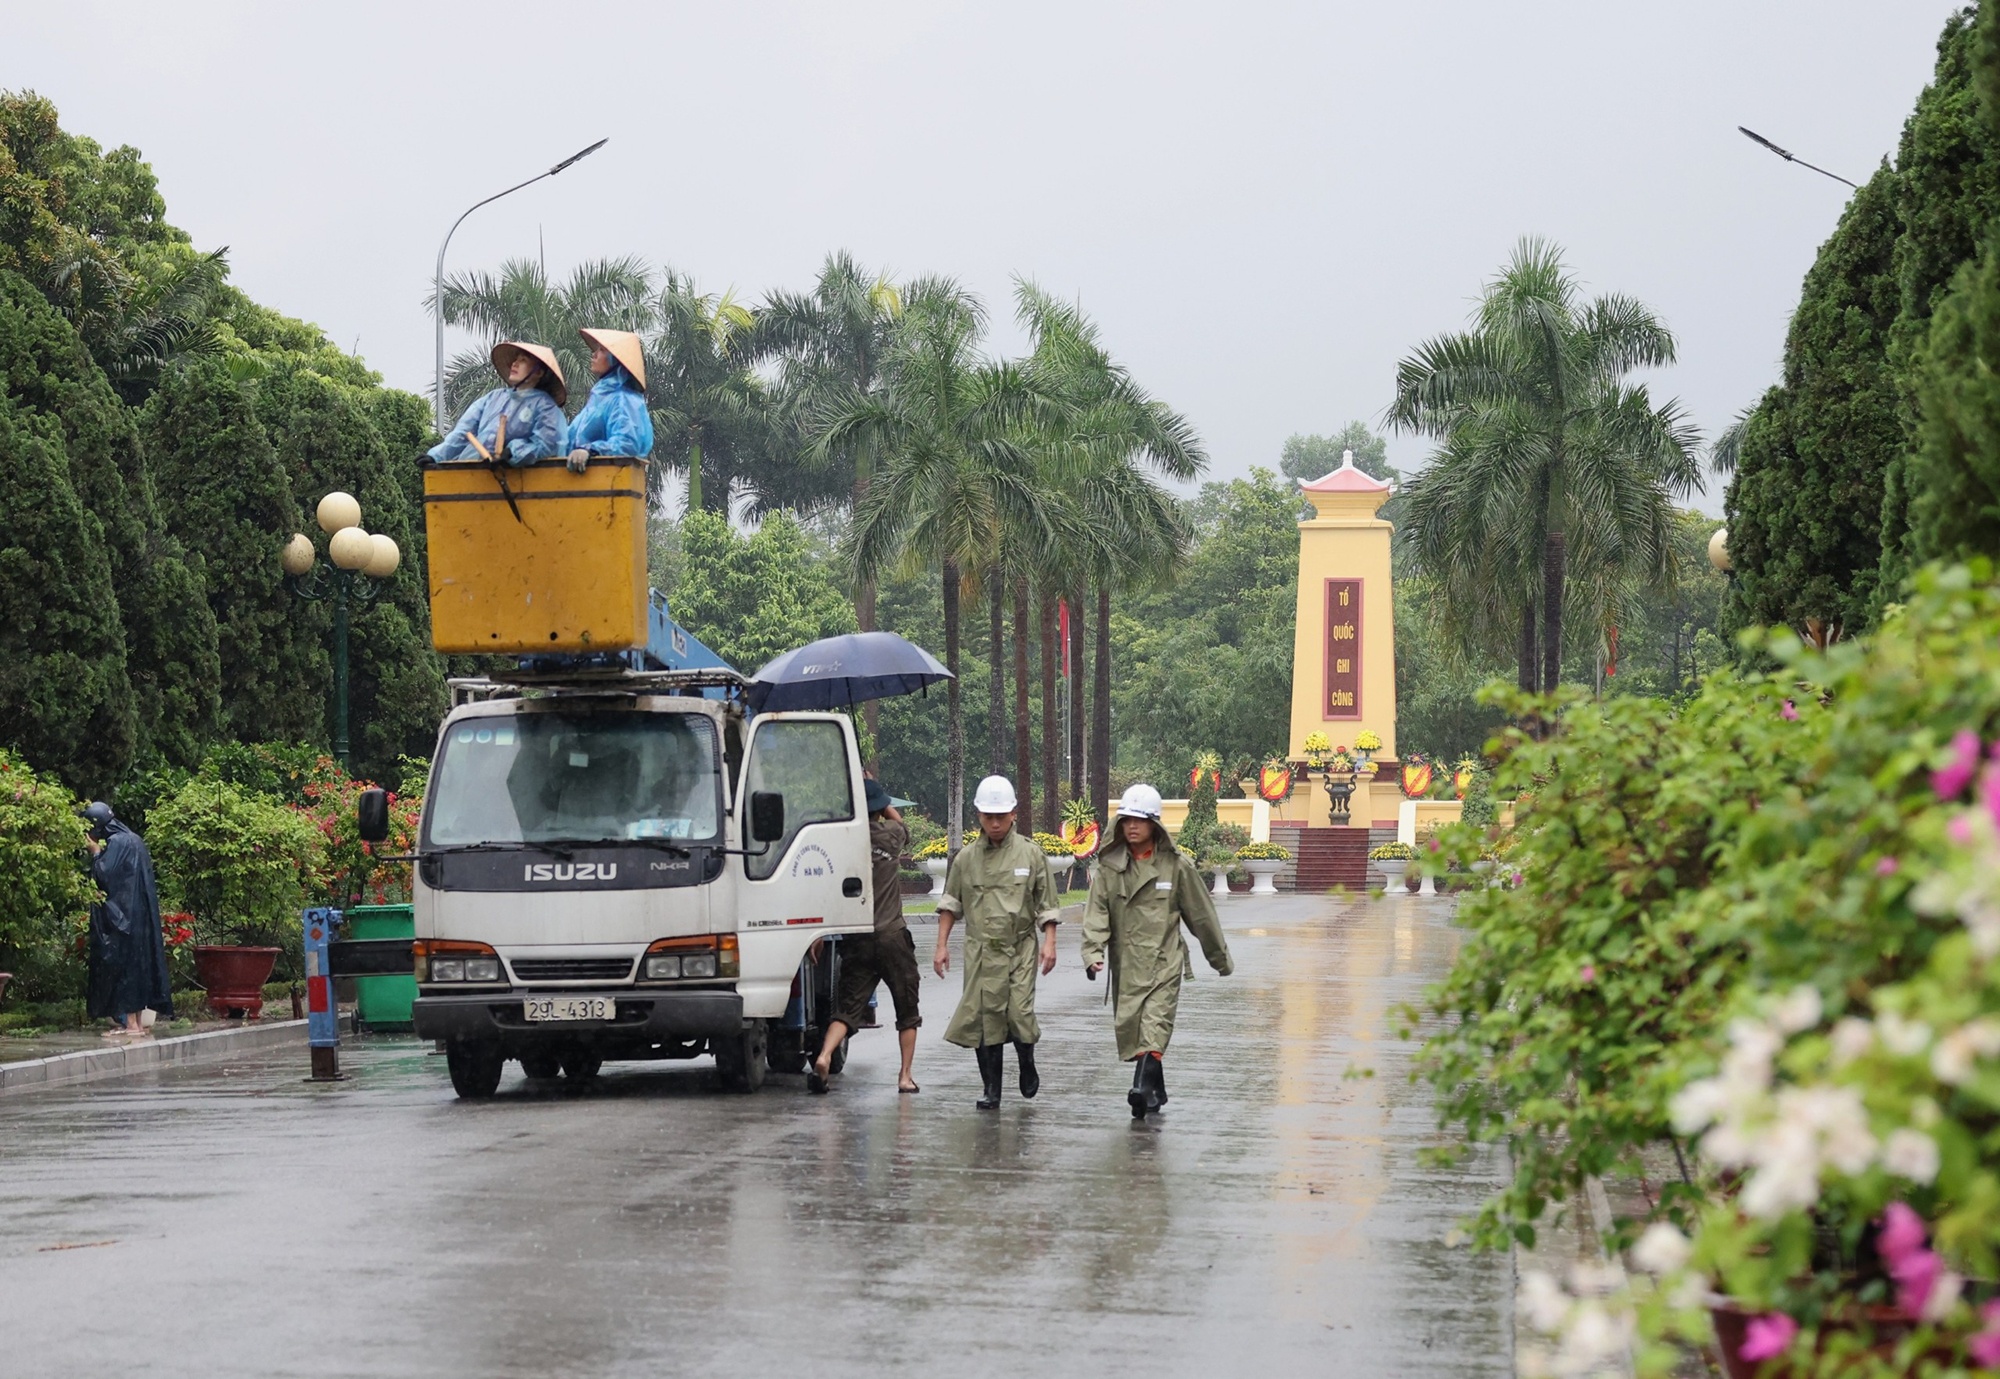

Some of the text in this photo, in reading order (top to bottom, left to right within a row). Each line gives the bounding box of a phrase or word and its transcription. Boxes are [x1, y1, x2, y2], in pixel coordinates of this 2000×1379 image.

[1333, 620, 1354, 641] QUỐC
[1336, 659, 1350, 673] GHI
[1331, 689, 1353, 706] CÔNG
[524, 863, 617, 881] ISUZU
[650, 861, 690, 871] NKR
[529, 1001, 605, 1018] 29L-4313
